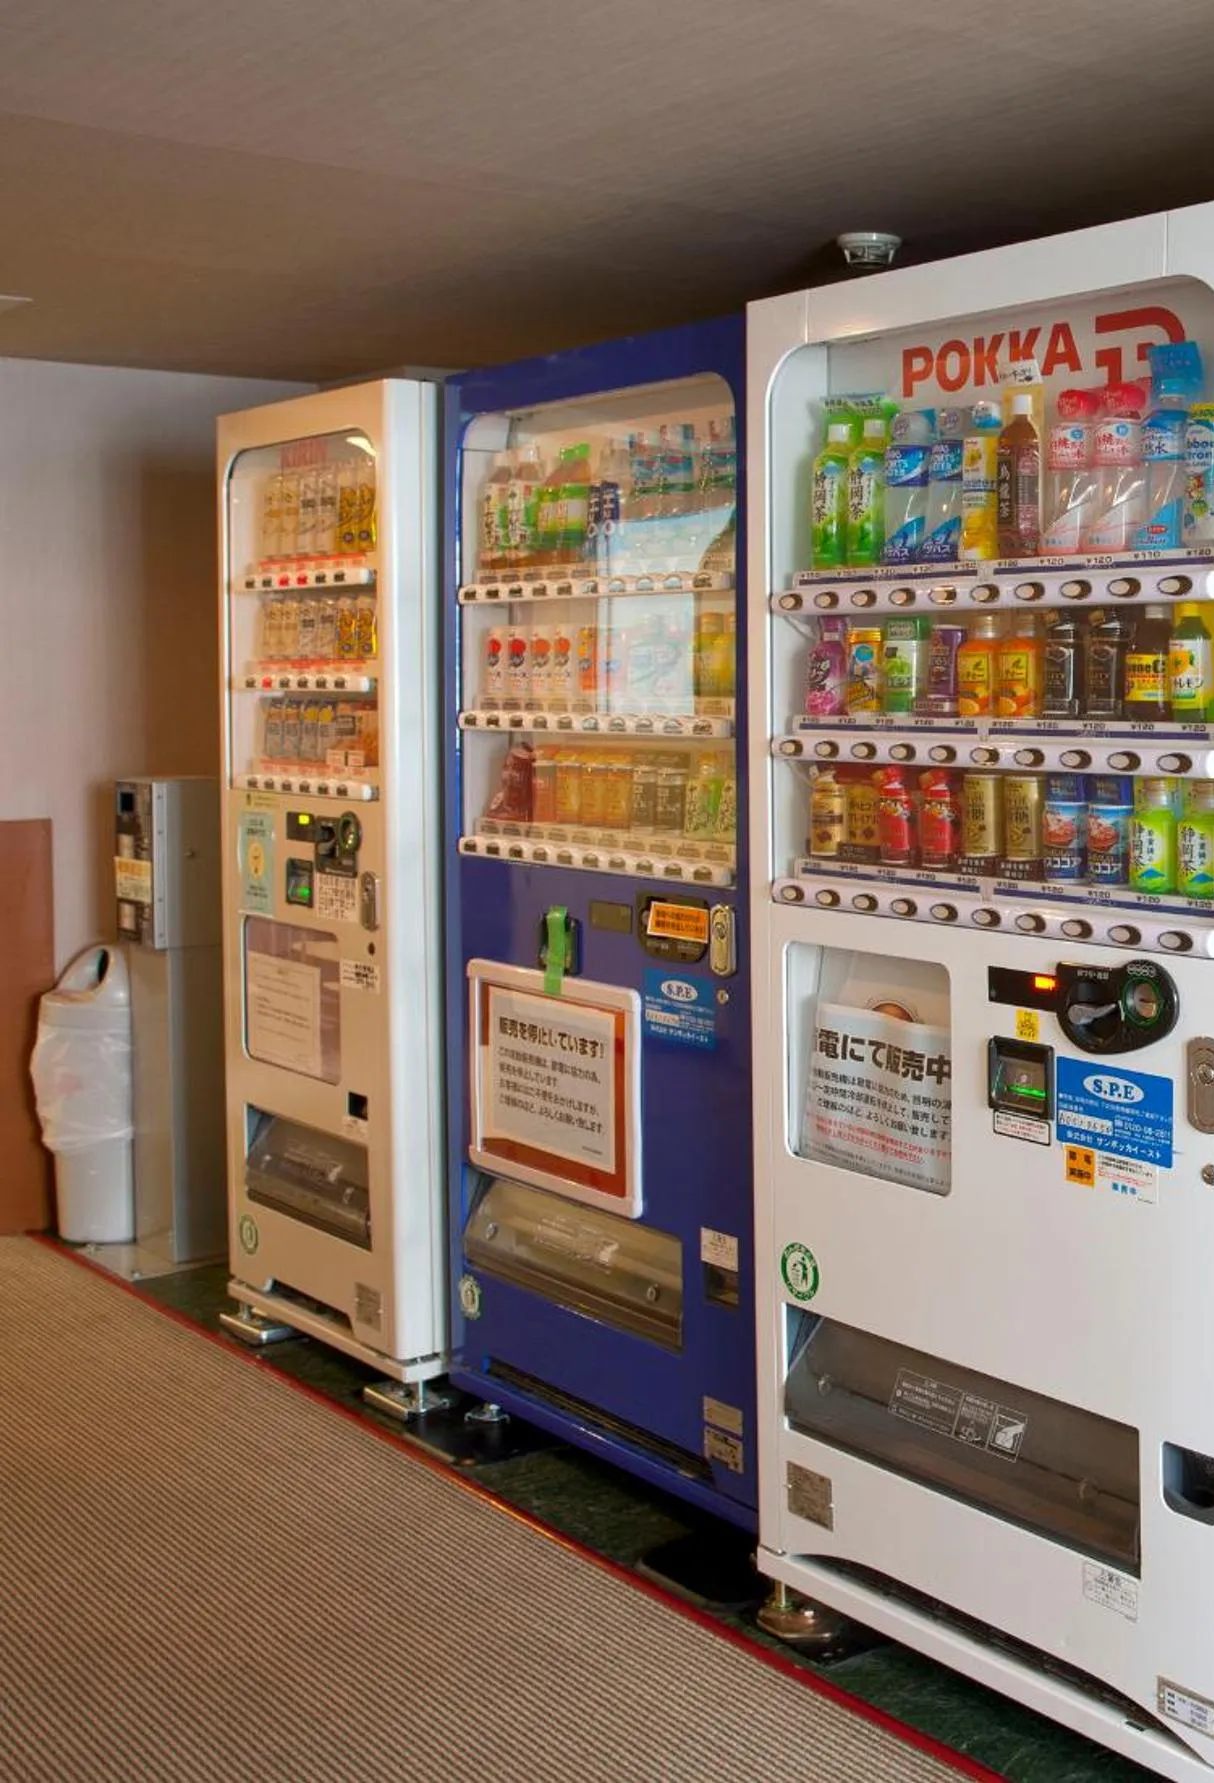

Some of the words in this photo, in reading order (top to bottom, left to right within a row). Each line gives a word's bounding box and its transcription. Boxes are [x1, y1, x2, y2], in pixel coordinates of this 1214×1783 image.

[901, 321, 1083, 398] POKKA
[815, 1028, 951, 1085] 電にて販売中
[1093, 1079, 1135, 1101] S.P.E
